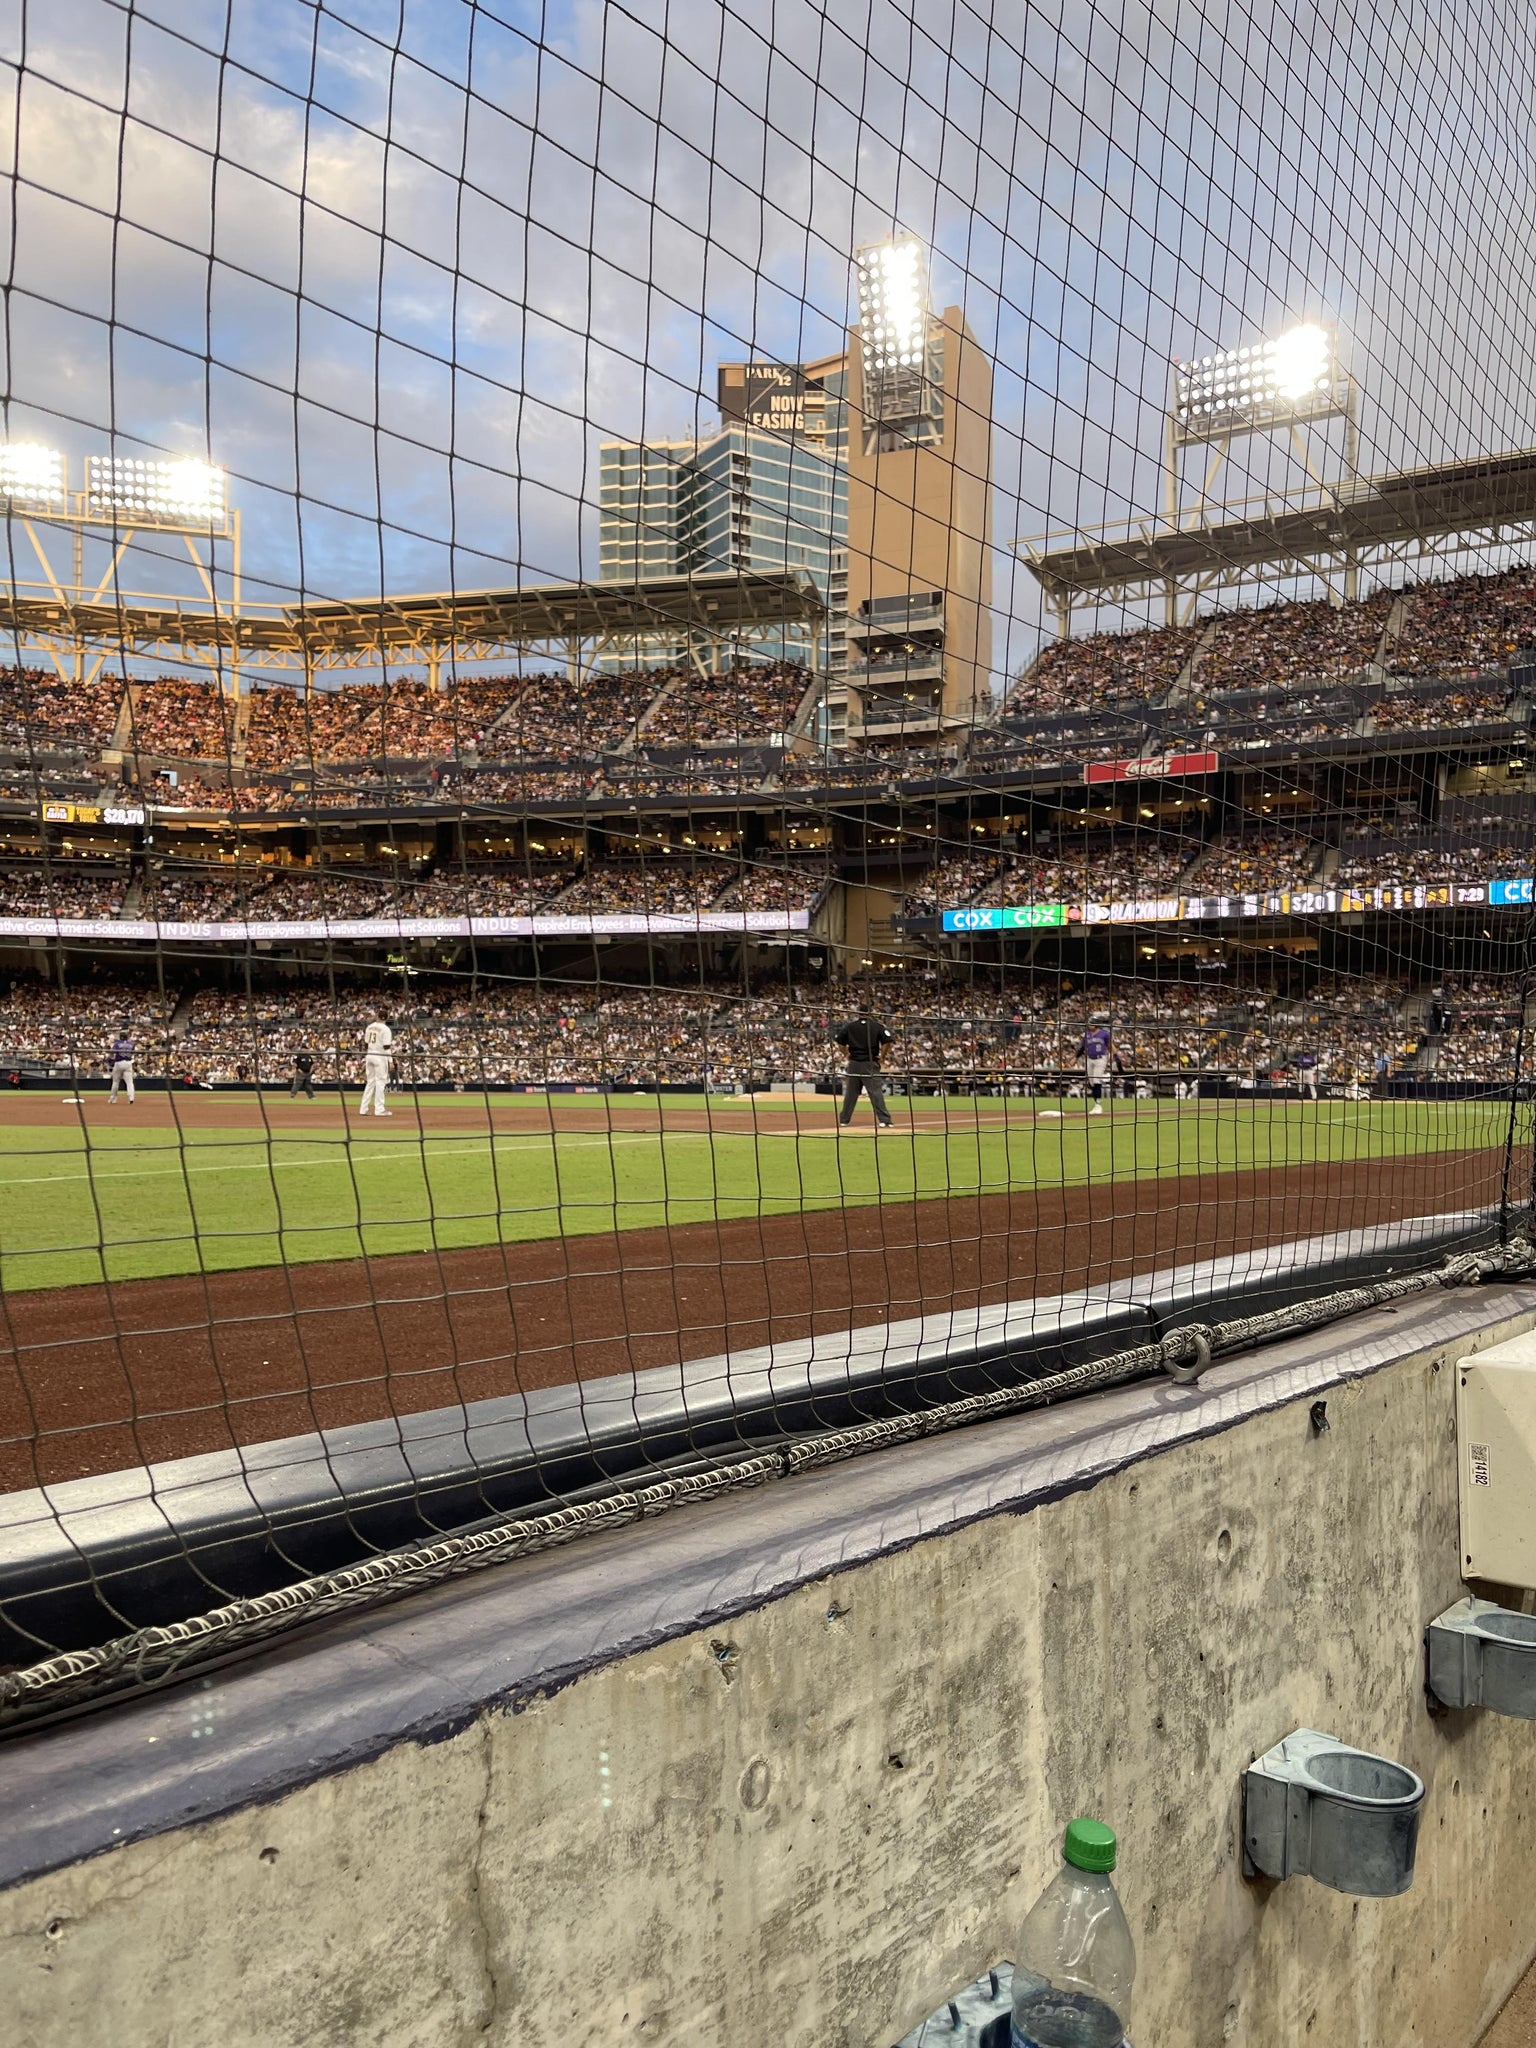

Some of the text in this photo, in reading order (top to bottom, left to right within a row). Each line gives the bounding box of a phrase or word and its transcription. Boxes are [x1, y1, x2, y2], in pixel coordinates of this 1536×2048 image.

[746, 367, 780, 379] PARK
[779, 375, 792, 387] 12
[770, 396, 804, 412] NOW
[745, 413, 804, 430] LEASING
[1013, 908, 1055, 925] COX
[1110, 900, 1179, 920] BLACKMON
[472, 918, 519, 931] INDUS
[572, 918, 623, 932] Employees
[630, 917, 681, 929] Innovative
[682, 916, 744, 928] Government
[747, 915, 794, 927] Solutions
[953, 912, 992, 928] COX
[26, 921, 94, 935] Government
[95, 923, 144, 936] Solutions
[160, 923, 212, 937] INDUS
[220, 925, 256, 939] Inspired
[256, 924, 305, 938] Employees
[310, 923, 357, 935] Innovative
[359, 922, 416, 935] Government
[417, 922, 460, 933] Solutions
[369, 1033, 377, 1044] 13
[1475, 1462, 1488, 1485] 14182
